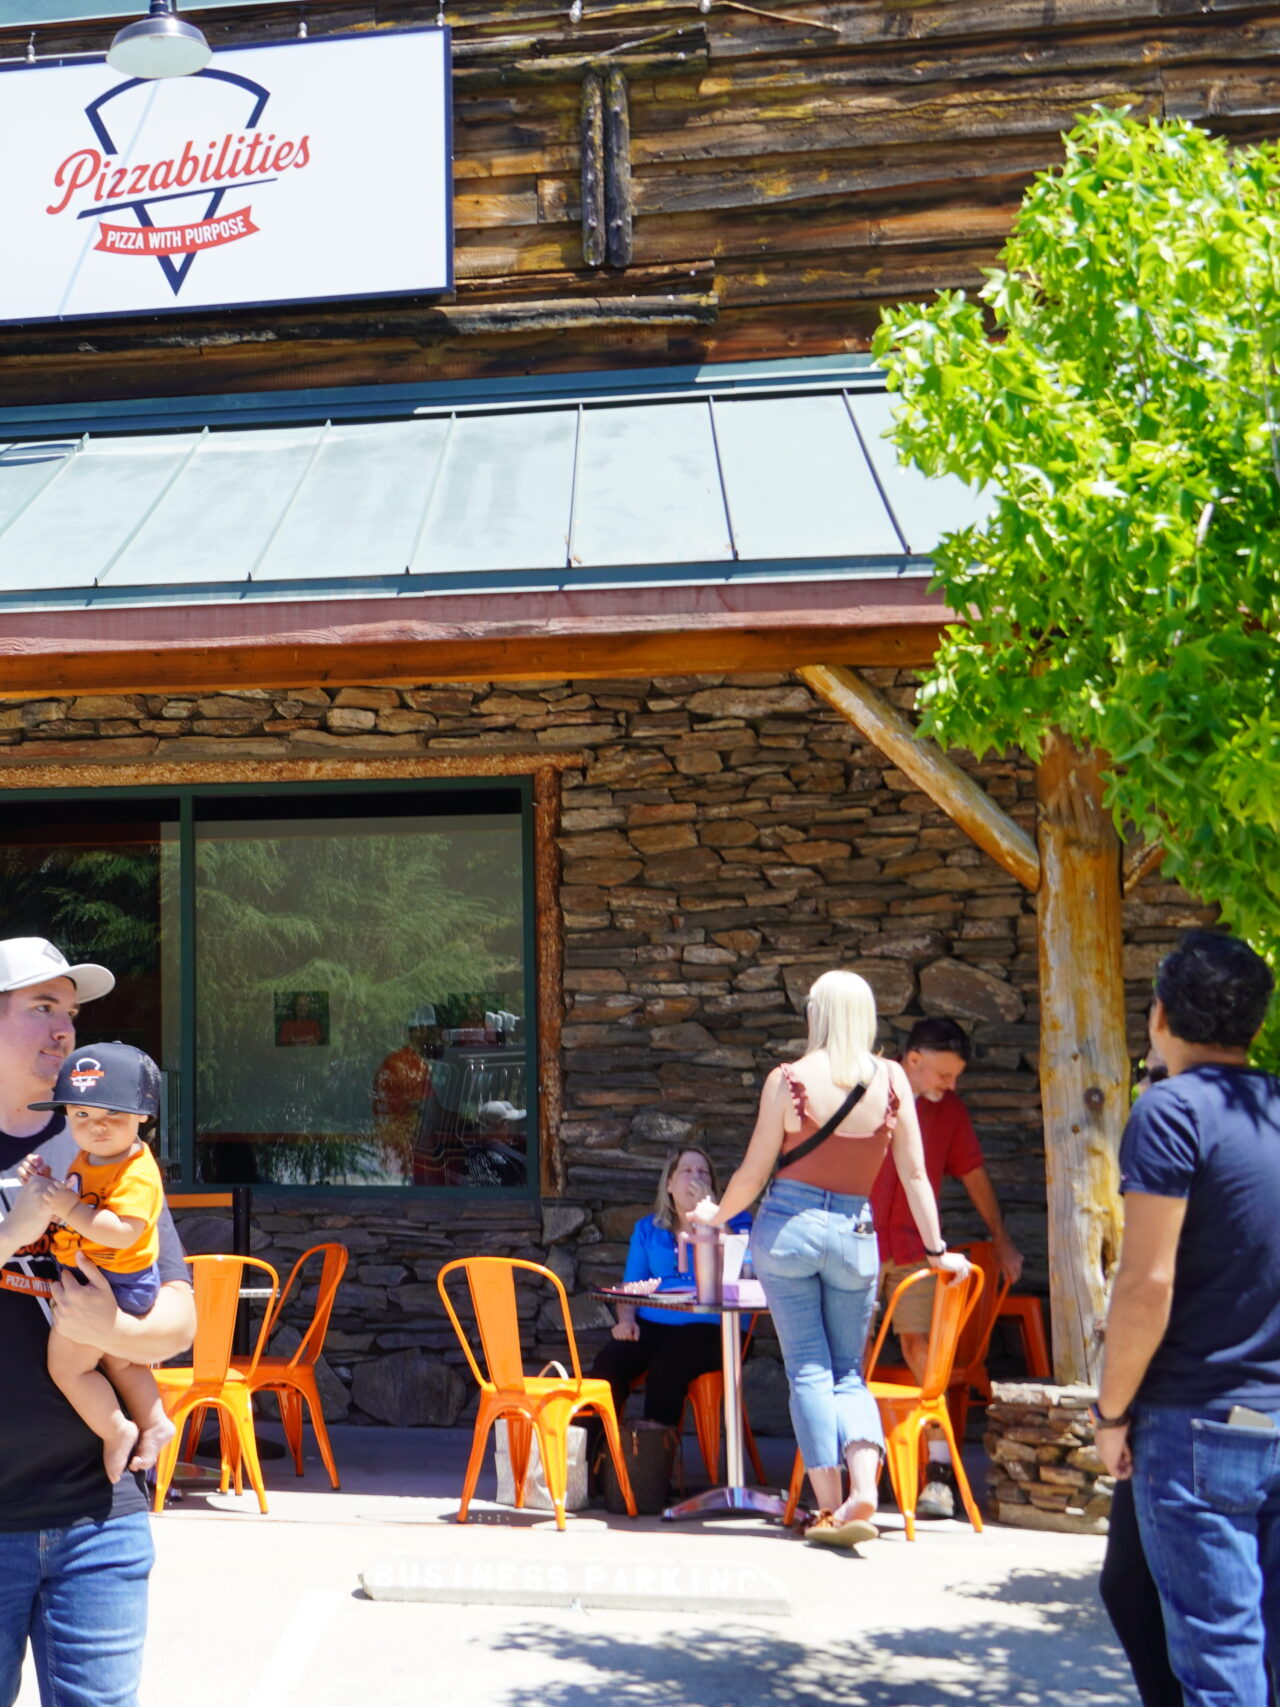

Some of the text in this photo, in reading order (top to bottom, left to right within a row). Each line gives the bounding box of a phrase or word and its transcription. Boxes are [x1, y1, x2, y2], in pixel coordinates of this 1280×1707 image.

[46, 133, 310, 215] Pizzabilities
[106, 215, 247, 249] PIZZA WITH PURPOSE
[6, 1274, 30, 1289] PIZZA
[373, 1562, 569, 1592] BUSINESS
